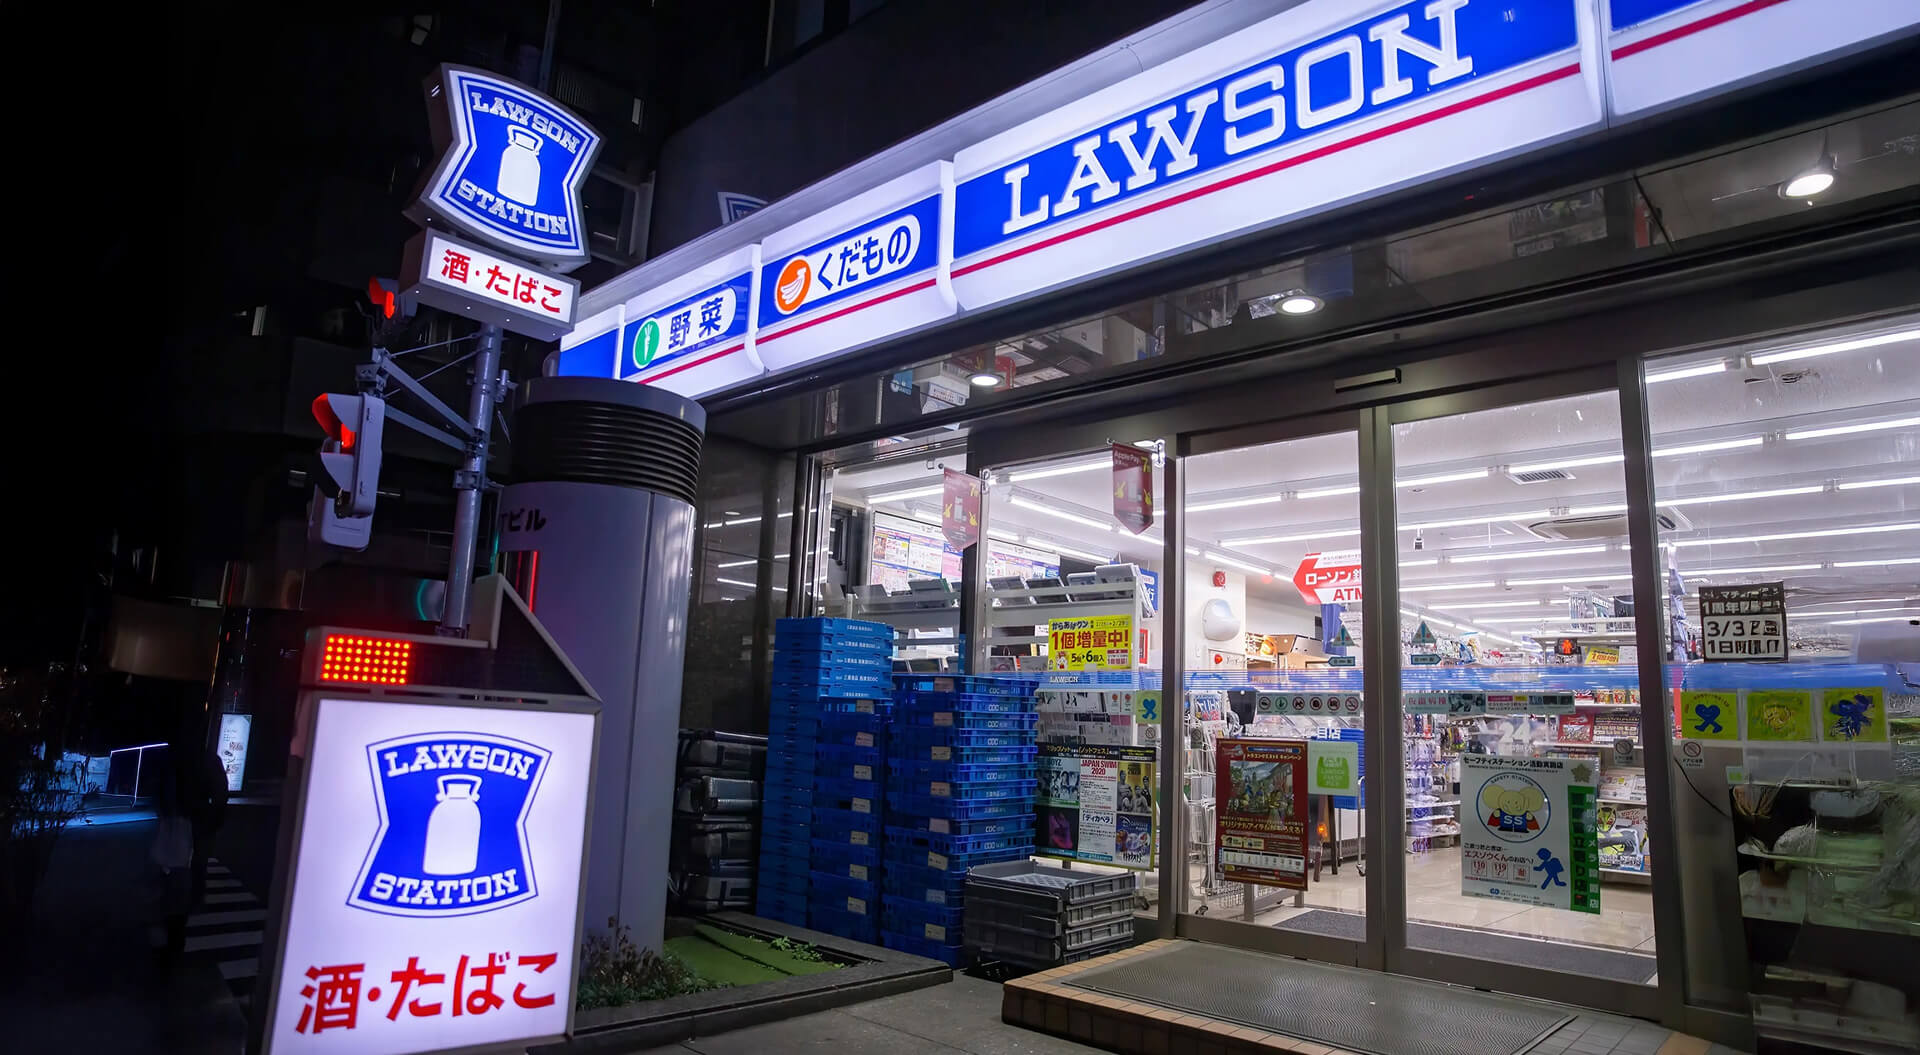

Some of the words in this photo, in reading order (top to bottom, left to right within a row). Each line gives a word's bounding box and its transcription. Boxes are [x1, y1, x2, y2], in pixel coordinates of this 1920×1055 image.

[471, 91, 581, 155] LAWSON
[1002, 0, 1475, 236] LAWSON
[457, 178, 569, 237] STATION
[441, 248, 562, 314] 酒・たばこ
[816, 224, 913, 292] くだもの
[668, 296, 724, 350] 野菜
[1051, 629, 1129, 650] 1個増量中!
[1052, 620, 1089, 630] からあげクン
[386, 743, 535, 781] LAWSON
[1080, 760, 1100, 768] JAPAN
[1100, 761, 1117, 769] SWIM
[1091, 767, 1106, 775] 2020
[1503, 815, 1523, 825] SS
[370, 869, 520, 905] STATION
[296, 952, 559, 1036] 酒・たばこ
